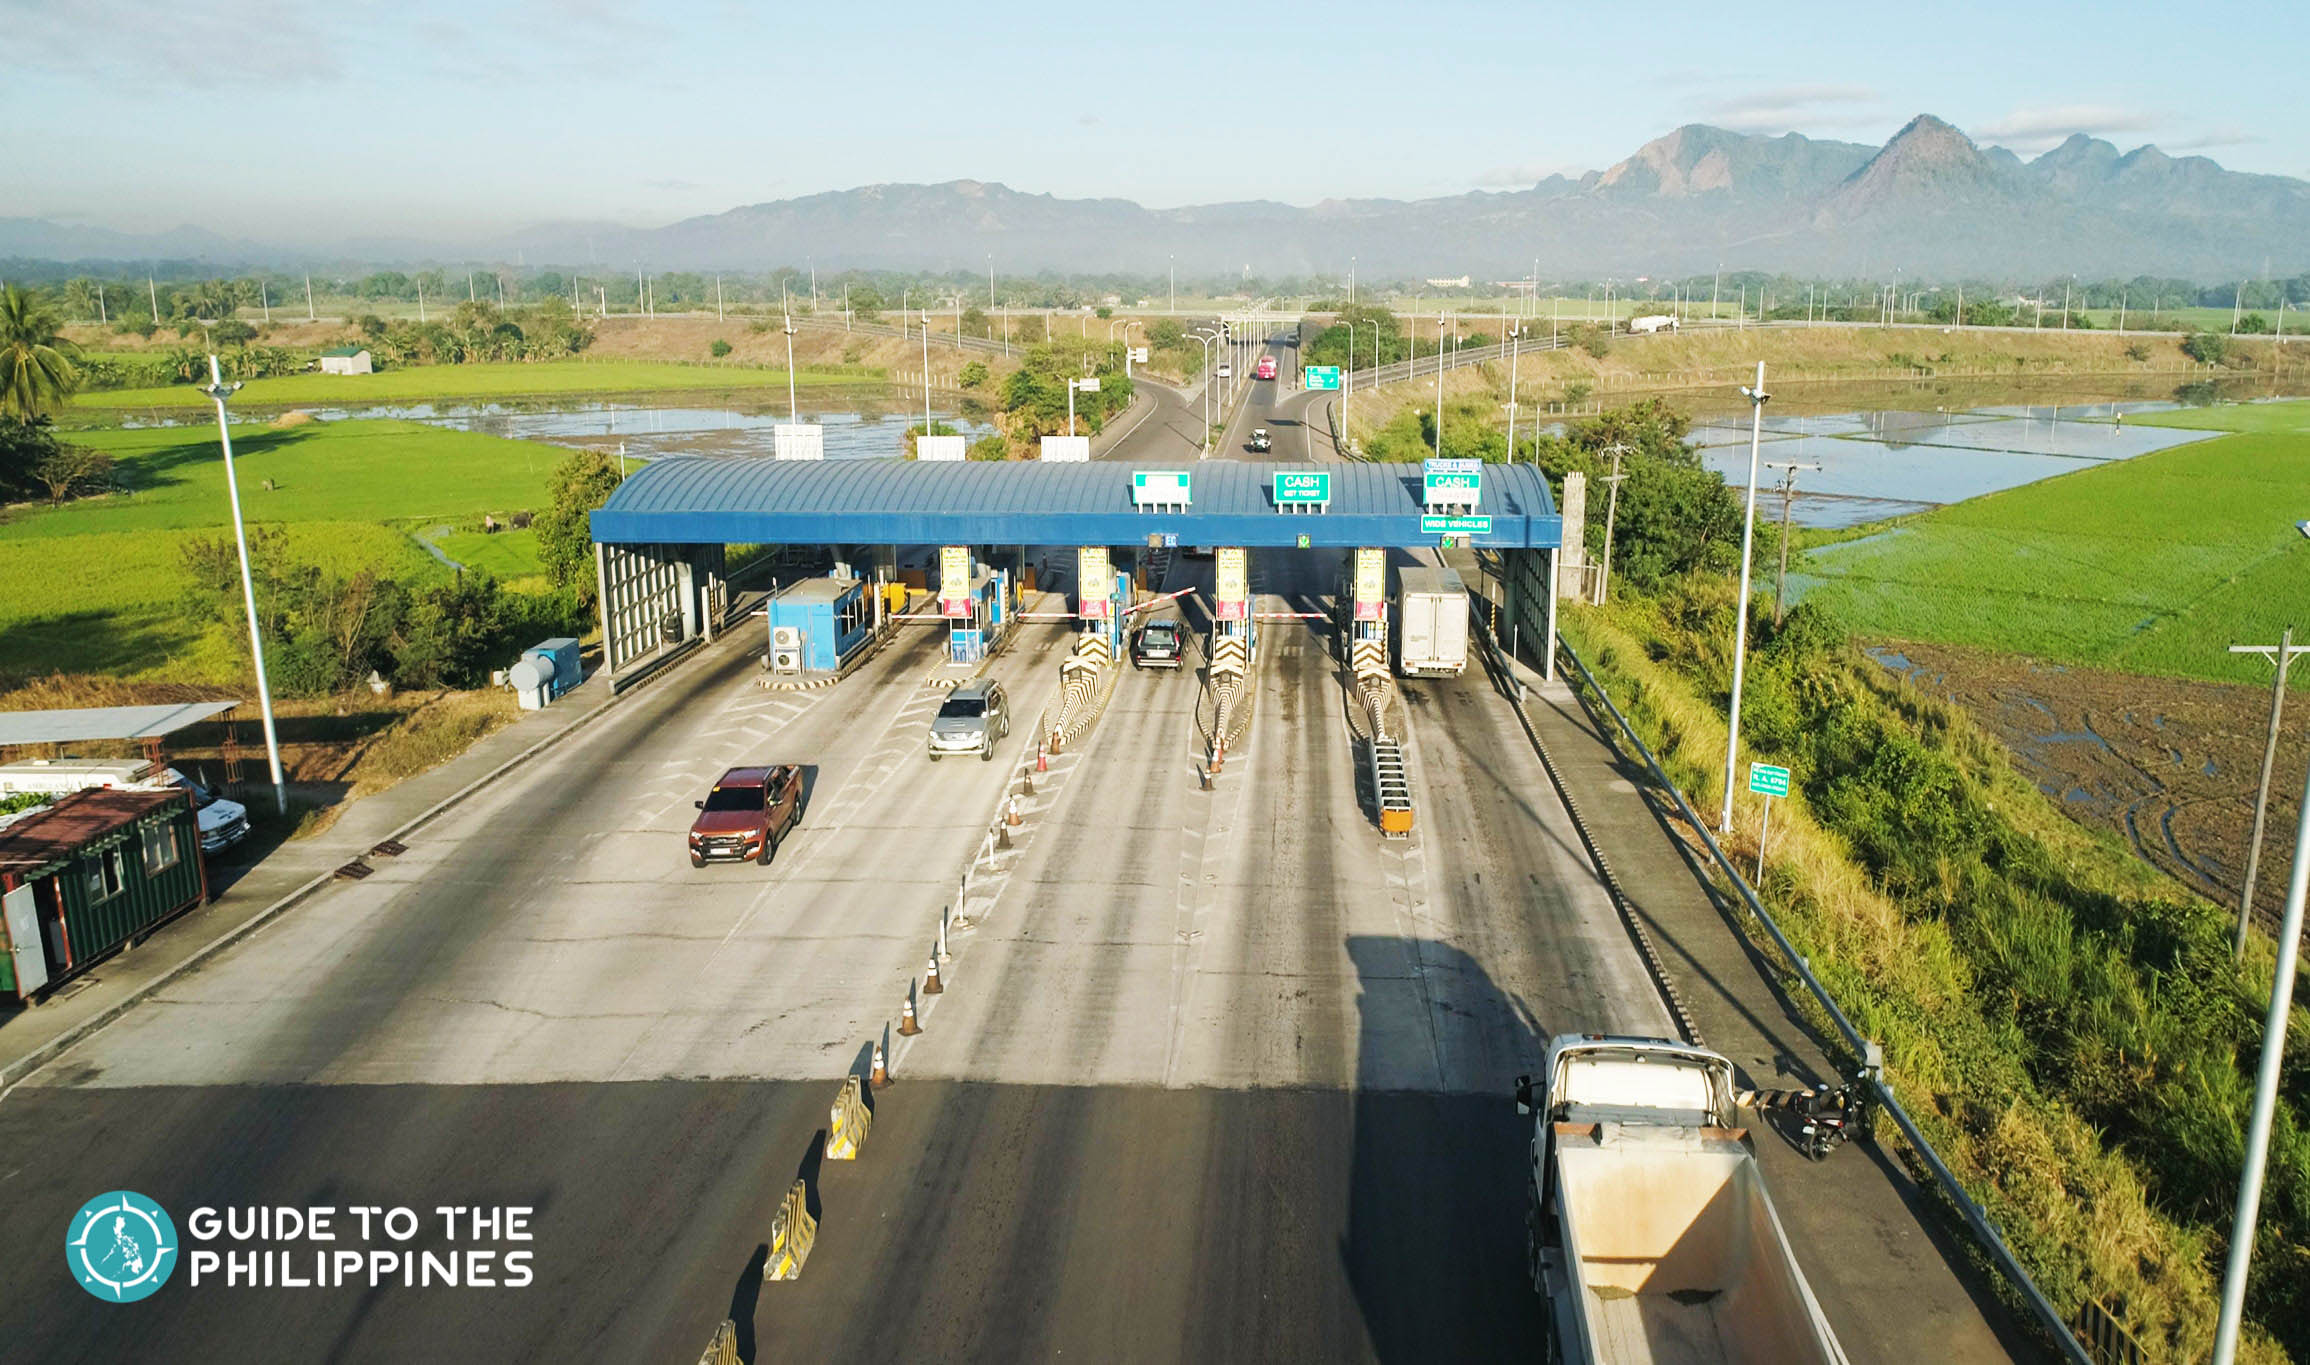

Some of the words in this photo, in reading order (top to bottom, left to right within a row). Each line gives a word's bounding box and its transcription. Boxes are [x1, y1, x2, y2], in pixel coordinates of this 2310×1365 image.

[1285, 476, 1320, 487] CASH
[1435, 477, 1470, 488] CASH
[1424, 520, 1446, 528] WIDE
[1447, 520, 1489, 528] VEHICLES
